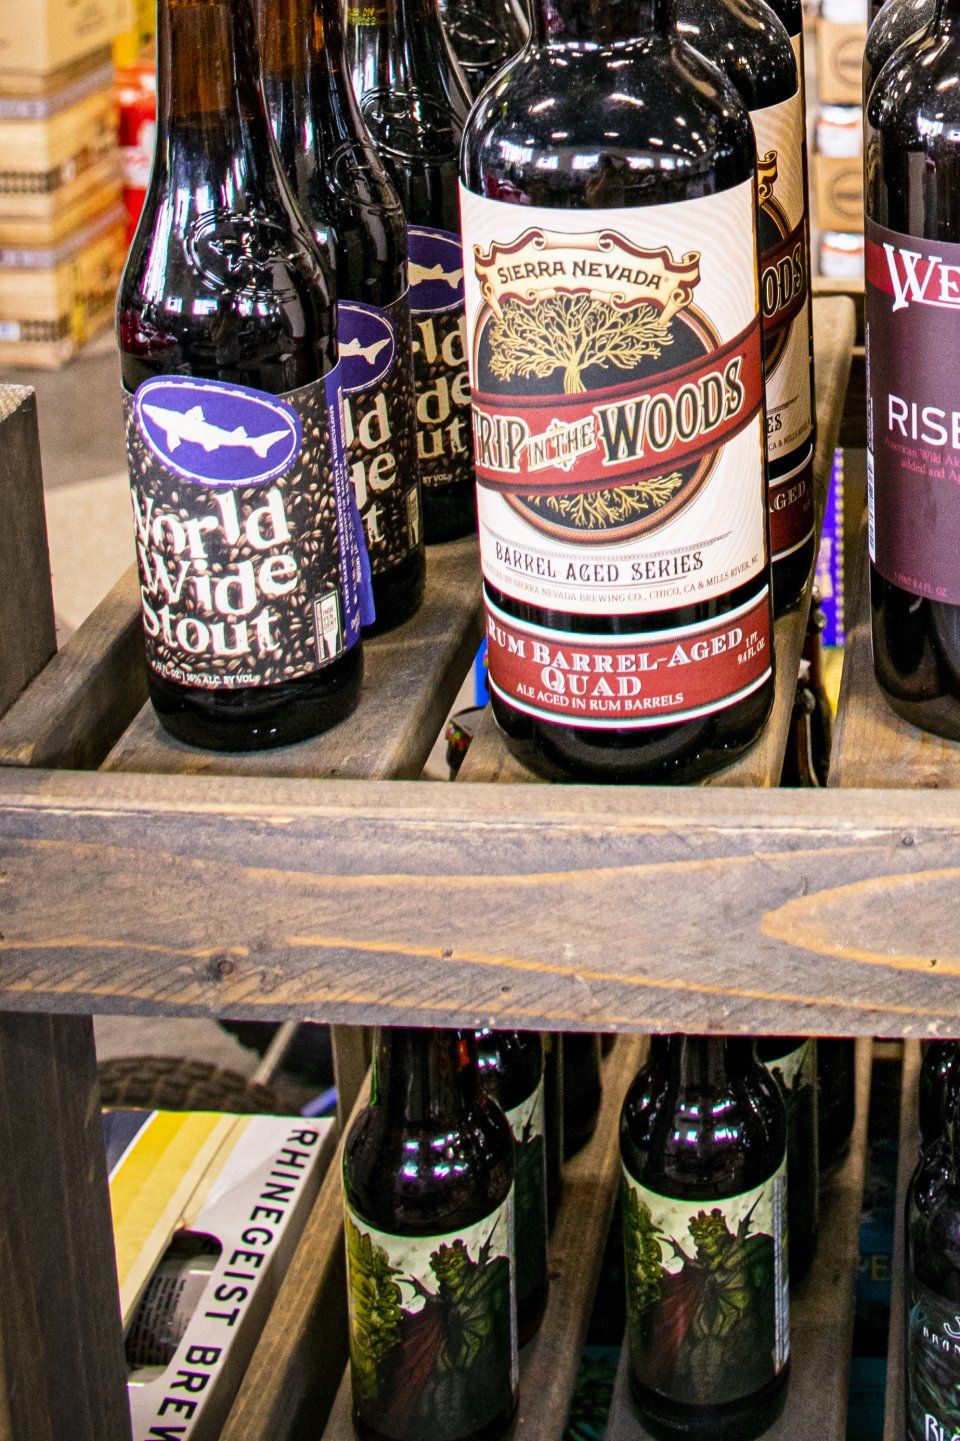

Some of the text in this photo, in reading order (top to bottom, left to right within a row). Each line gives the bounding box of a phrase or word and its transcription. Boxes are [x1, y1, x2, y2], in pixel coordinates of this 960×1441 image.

[497, 259, 662, 291] SIERRA NEVADA
[528, 438, 547, 469] IN
[550, 420, 593, 458] THE
[593, 356, 745, 466] WOODS
[920, 447, 942, 465] Wild
[928, 466, 945, 479] and
[137, 541, 299, 616] Wide
[496, 540, 557, 578] BARREL
[566, 561, 619, 582] AGED
[631, 550, 704, 582] SERIES
[141, 585, 281, 657] Stout
[488, 617, 744, 673] RUM BARREL-AGED
[516, 682, 684, 711] ALE AGED IN RUM BARRELS
[540, 666, 642, 697] QUAD
[204, 1127, 320, 1327] RHINEGEIST
